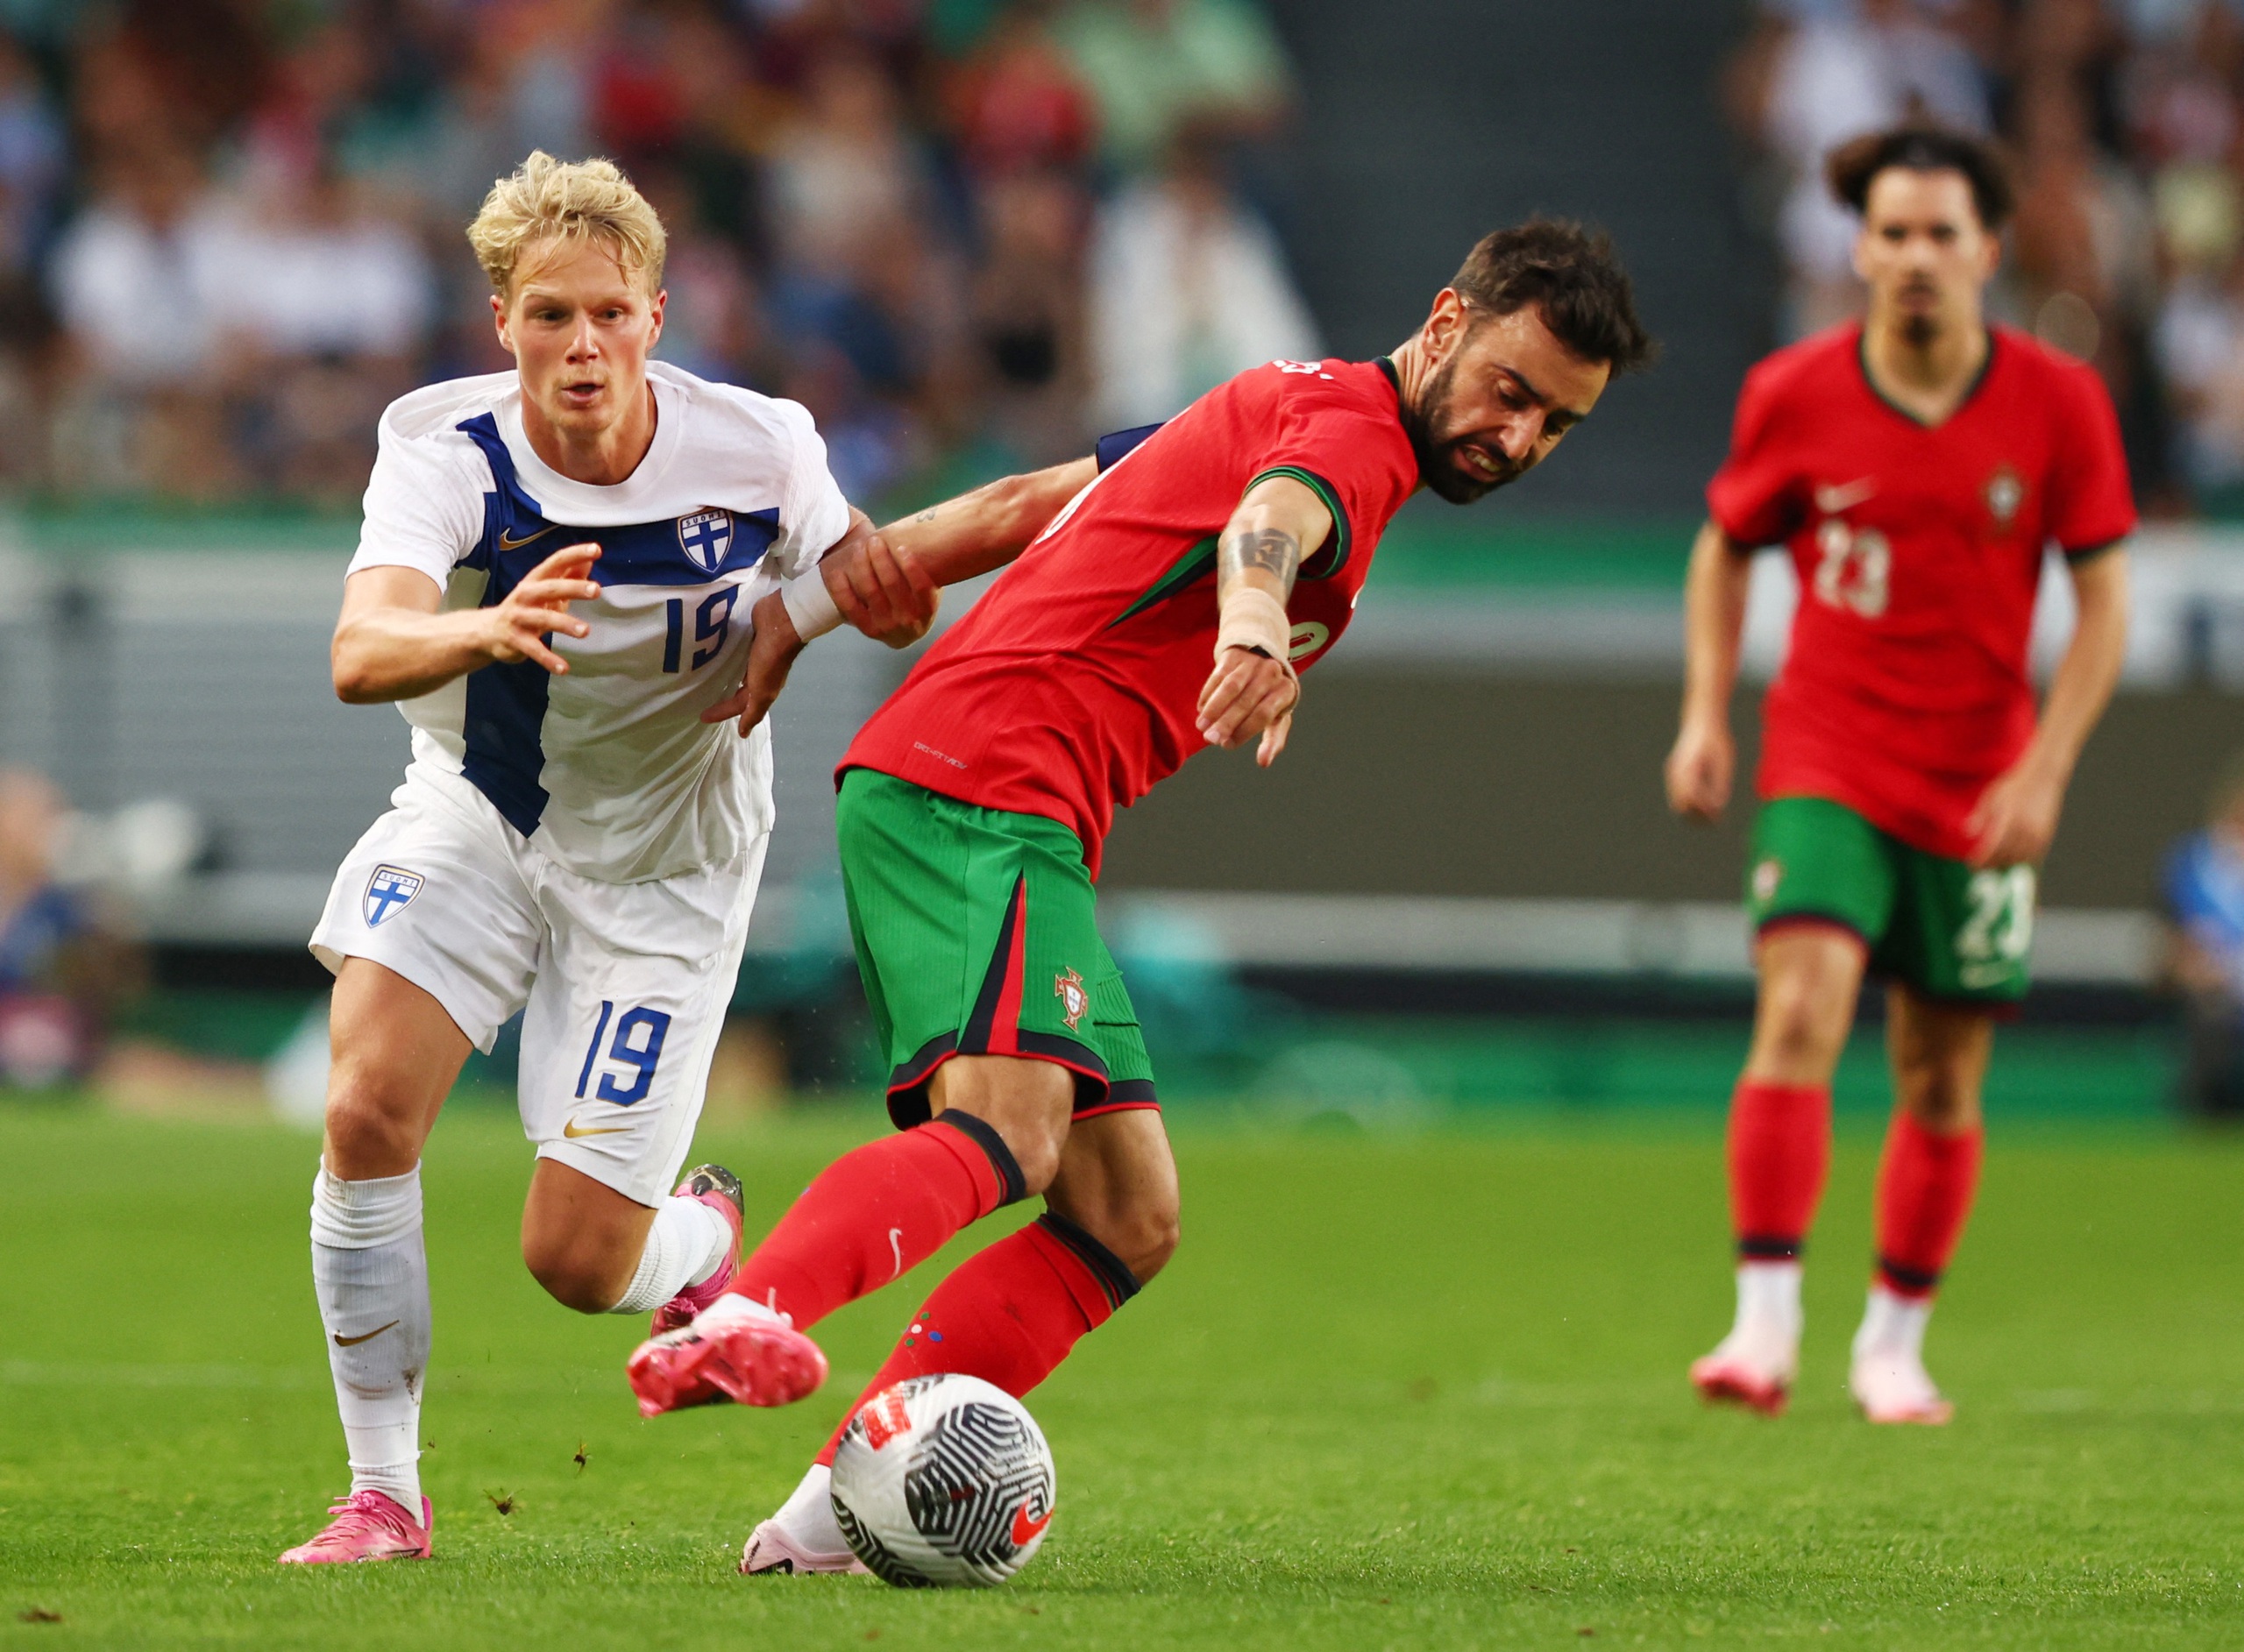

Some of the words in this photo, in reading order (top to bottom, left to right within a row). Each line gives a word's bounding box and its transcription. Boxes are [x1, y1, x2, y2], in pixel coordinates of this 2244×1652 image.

[685, 511, 721, 526] SUOMI
[1814, 519, 1891, 619] 23
[663, 583, 740, 673] 19
[383, 873, 415, 886] SUOMI
[574, 999, 671, 1108] 19
